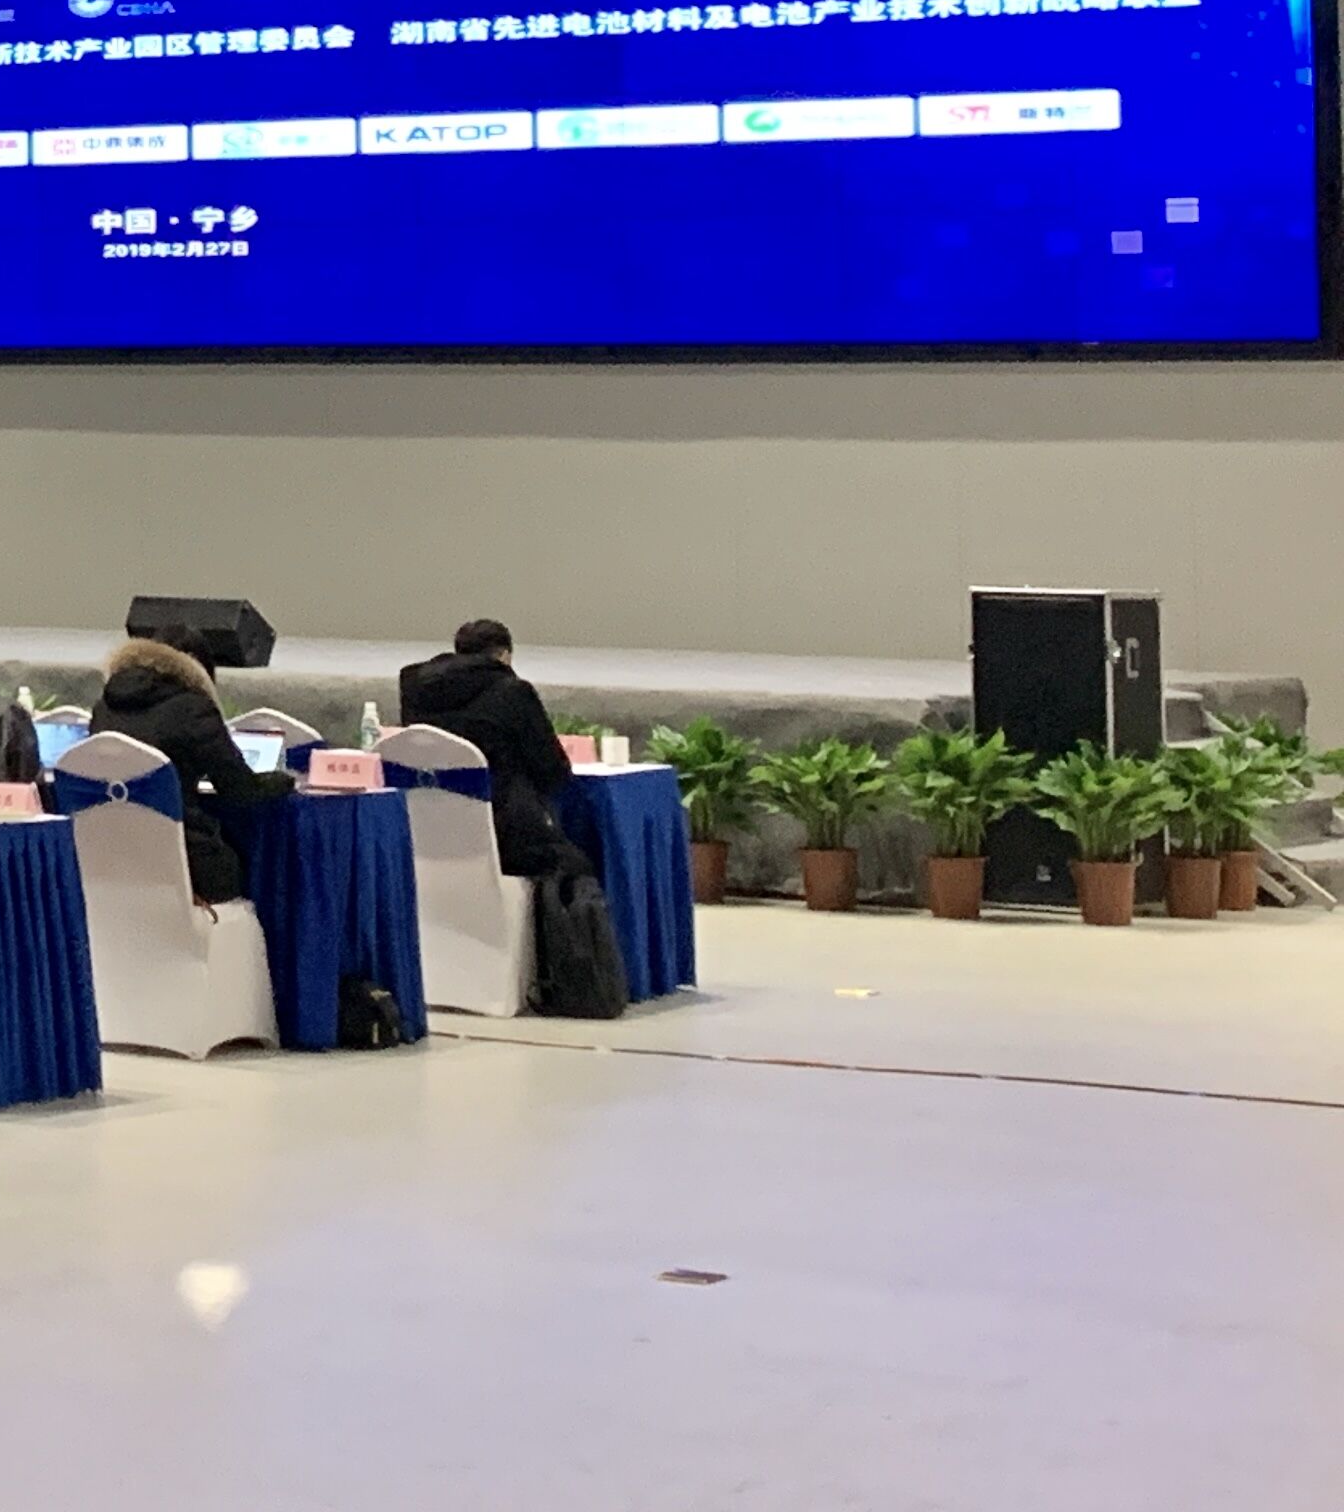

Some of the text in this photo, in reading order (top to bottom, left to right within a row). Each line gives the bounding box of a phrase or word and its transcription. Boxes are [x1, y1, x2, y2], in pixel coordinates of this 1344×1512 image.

[375, 124, 508, 143] KATOP
[102, 240, 250, 258] 2019年2月27日
